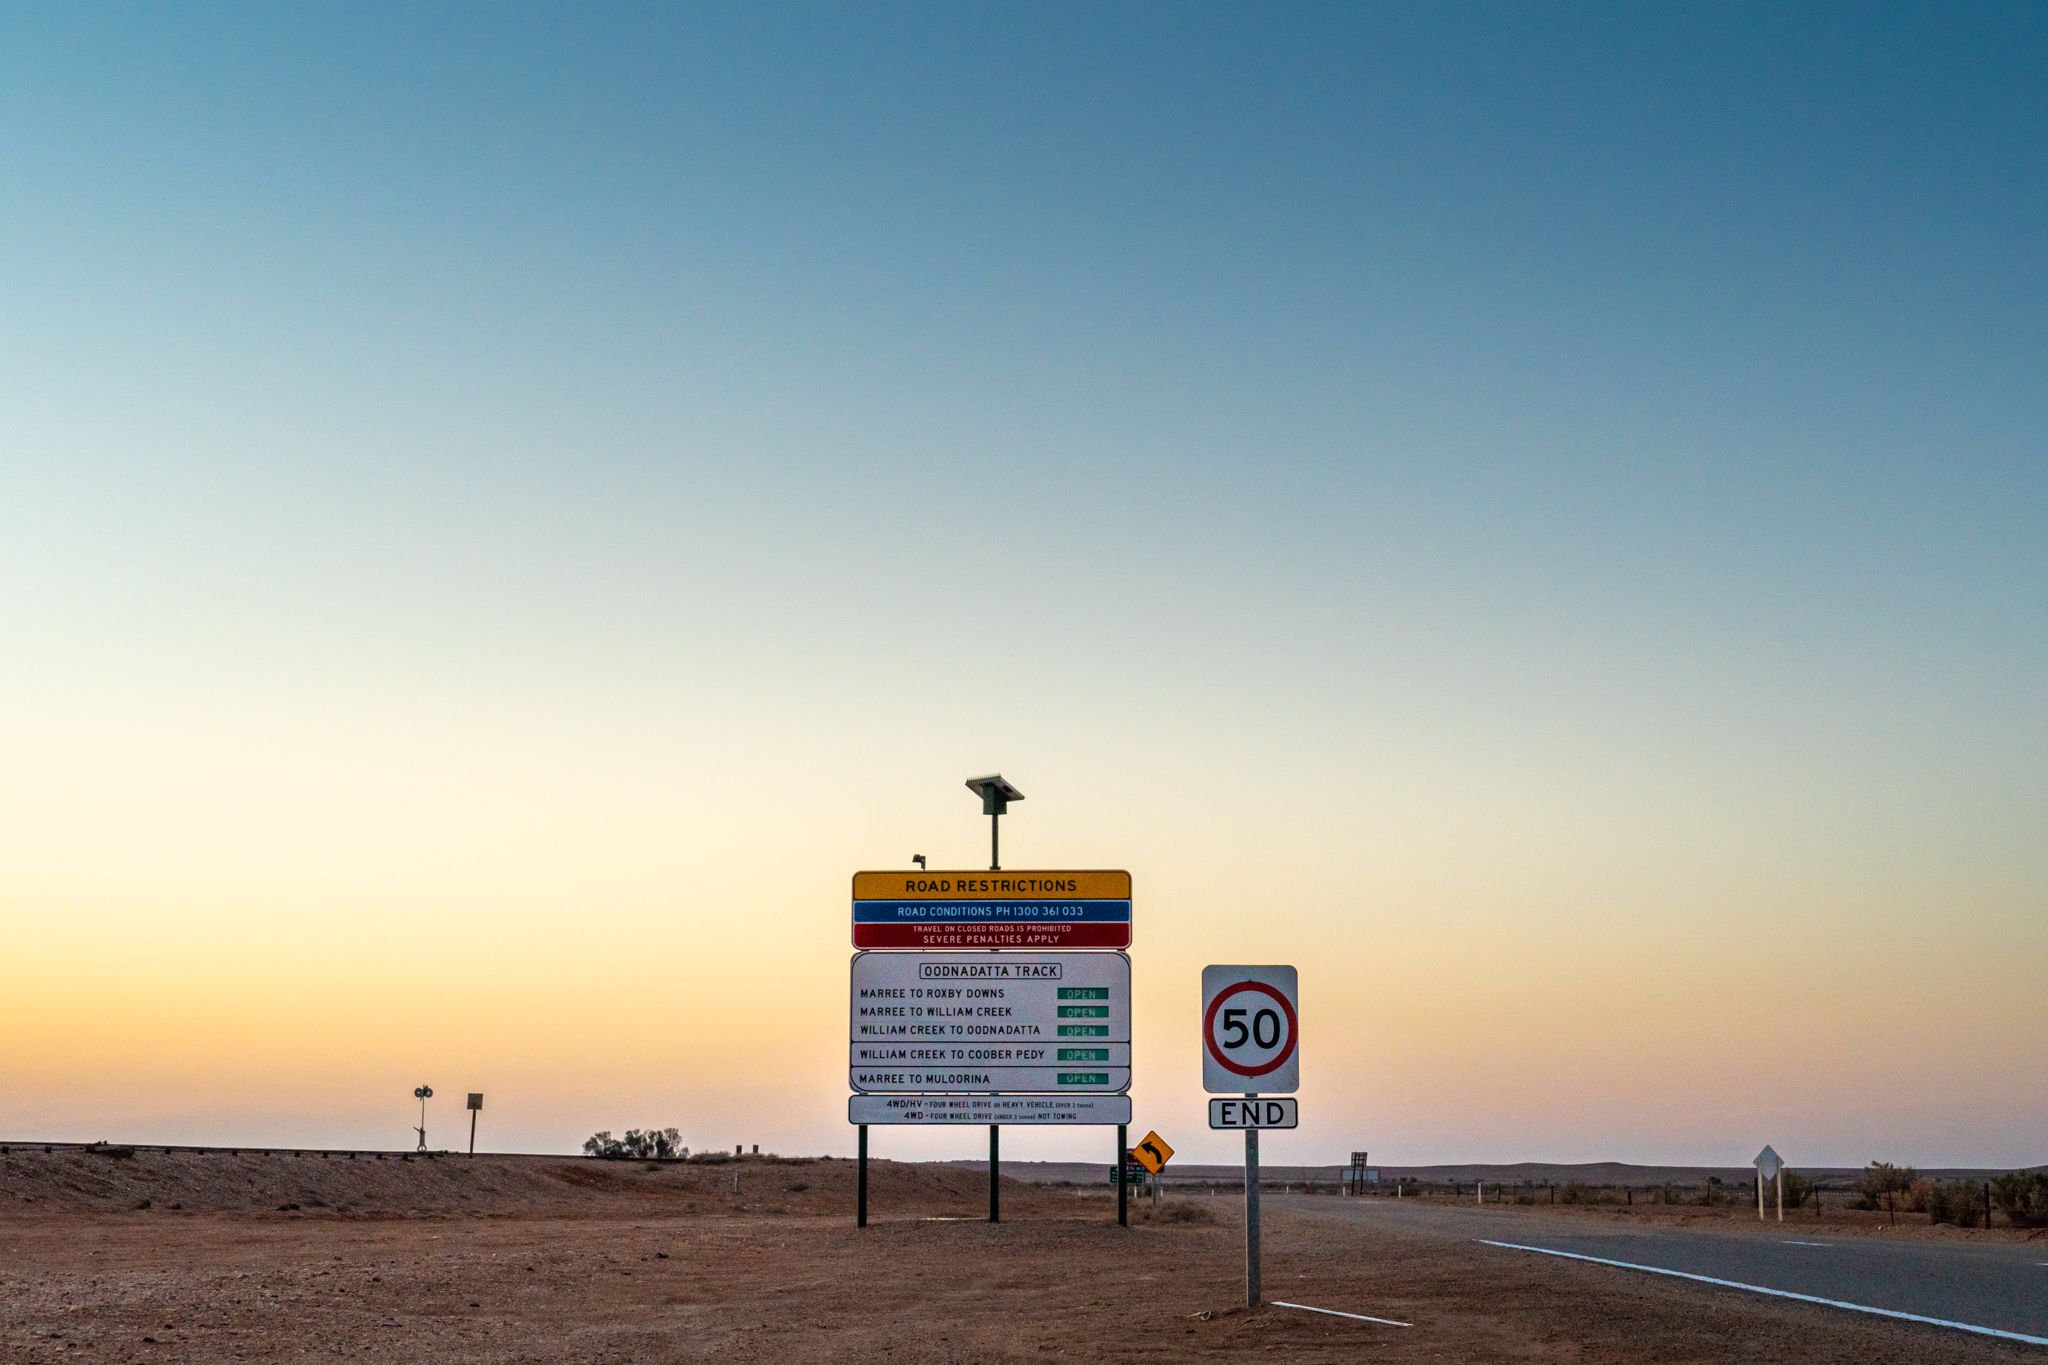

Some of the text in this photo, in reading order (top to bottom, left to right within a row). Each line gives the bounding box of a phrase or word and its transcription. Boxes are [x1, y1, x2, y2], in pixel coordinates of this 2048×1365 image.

[906, 880, 1077, 892] ROAD RESTRICTIONS
[898, 906, 1083, 916] ROAD CONDITIONS PH 1300 361 033
[966, 935, 1022, 943] PENALTIES
[1027, 935, 1059, 943] APPLY
[924, 966, 1057, 976] OODNADATTA TRACK
[860, 989, 1004, 998] MARREE TO ROXBY DOWNS
[1067, 990, 1095, 999] OPEN
[860, 1007, 1012, 1016] MARREE TO WILLIAM CREEK
[1067, 1008, 1095, 1017] OPEN
[860, 1026, 1040, 1034] WILLIAM CREEK TO OODNADATTA
[1067, 1027, 1095, 1036] OPEN
[1223, 1009, 1280, 1049] 50
[860, 1050, 1044, 1059] WILLIAM CREEK TO COOBER PEDY
[1067, 1051, 1095, 1060] OPEN
[860, 1075, 990, 1084] MARREE TO MULOORINA
[1067, 1074, 1095, 1083] OPEN
[887, 1100, 922, 1108] 4WD/HV
[1222, 1102, 1284, 1125] END
